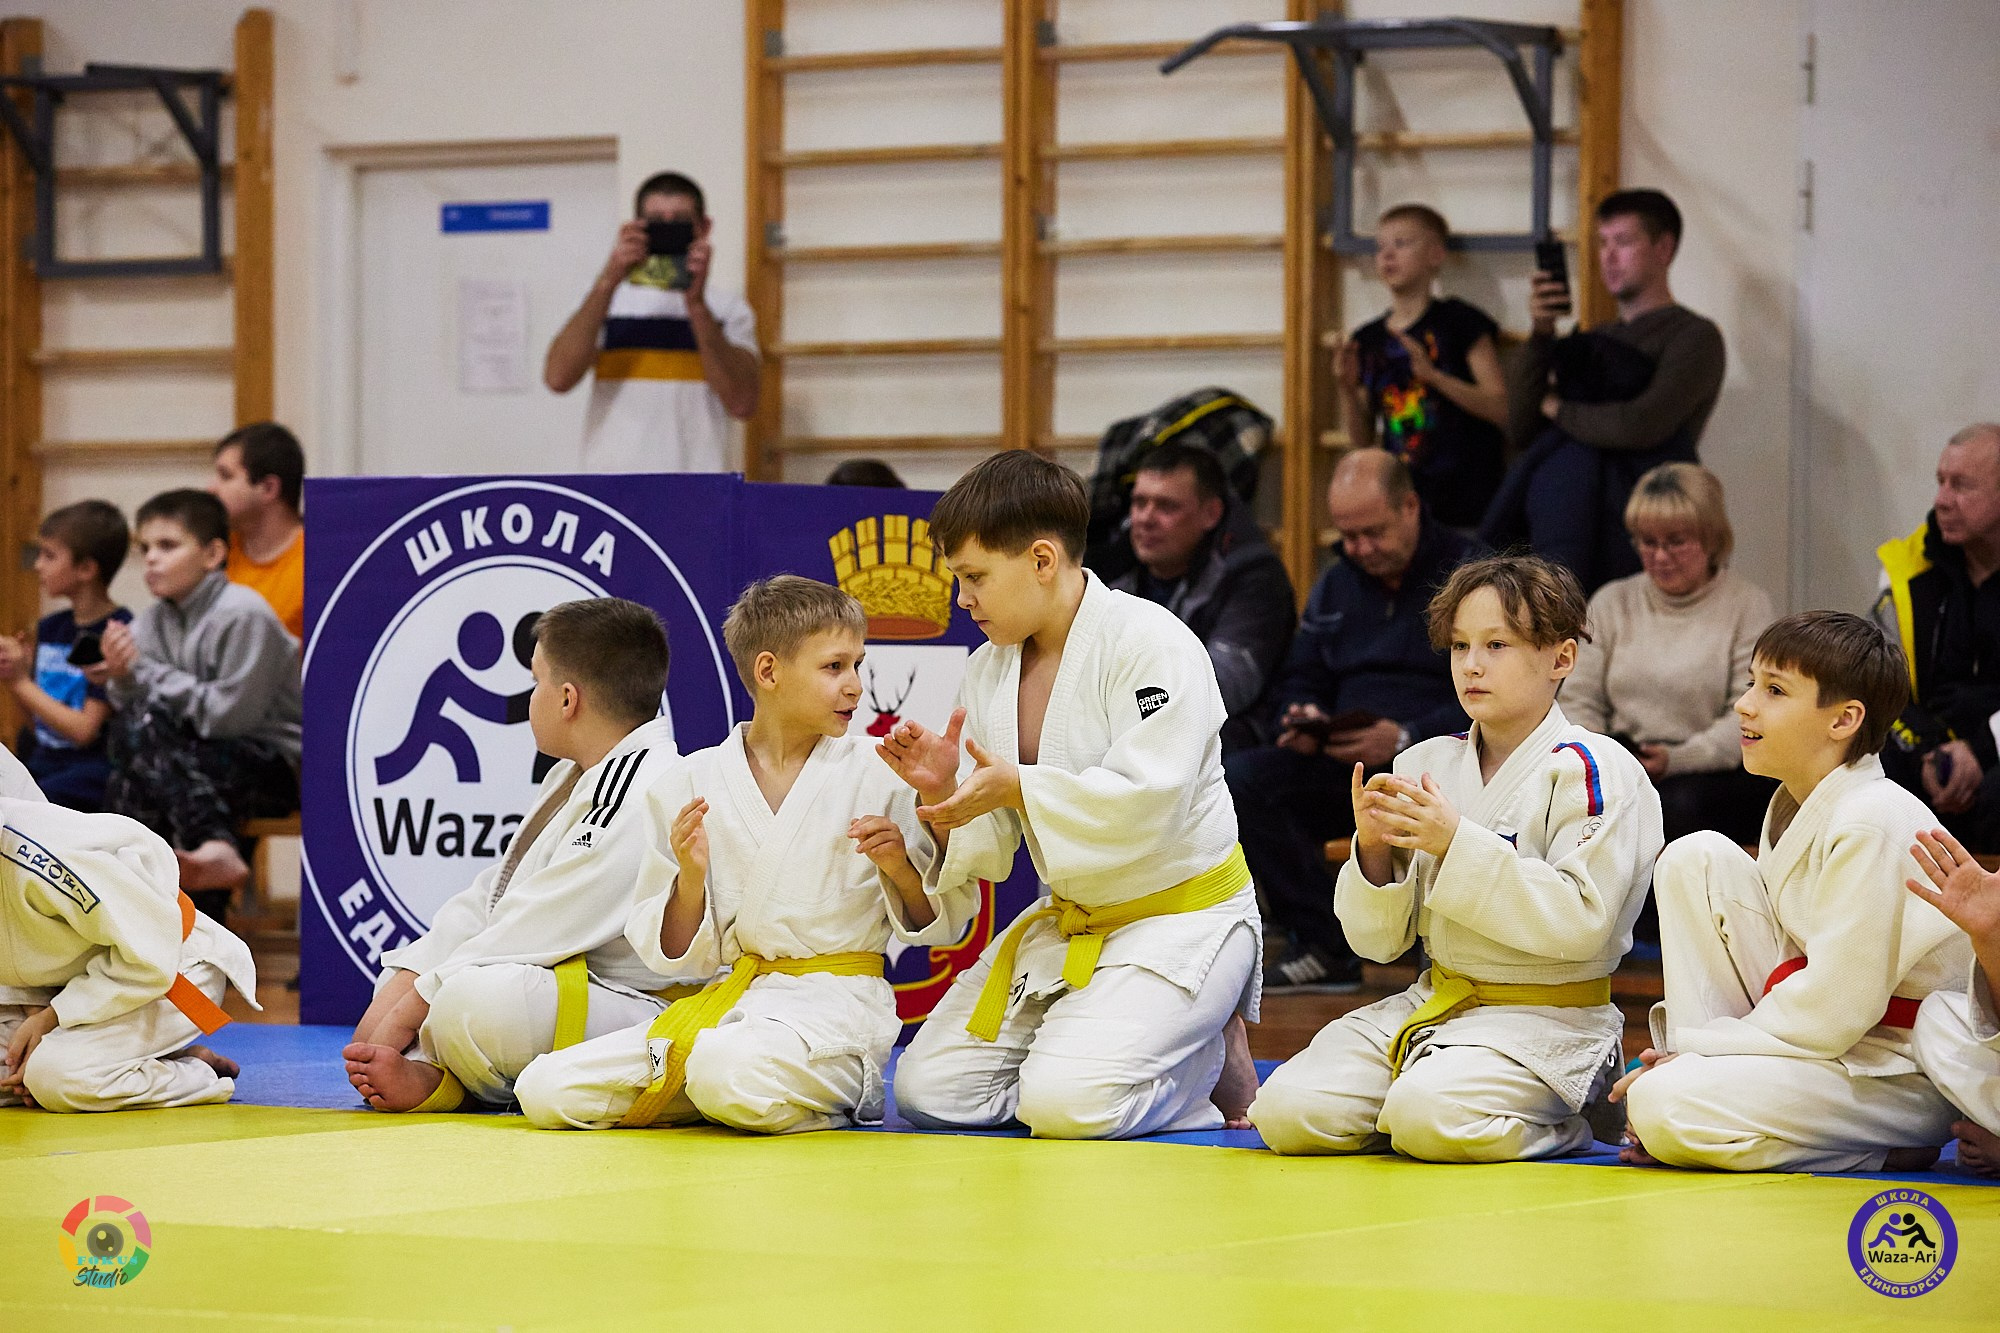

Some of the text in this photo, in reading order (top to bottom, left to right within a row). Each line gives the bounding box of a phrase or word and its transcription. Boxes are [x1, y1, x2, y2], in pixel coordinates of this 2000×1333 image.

[404, 503, 616, 577] ШКОЛА
[1138, 692, 1168, 706] GREEN
[1141, 700, 1164, 712] HILL
